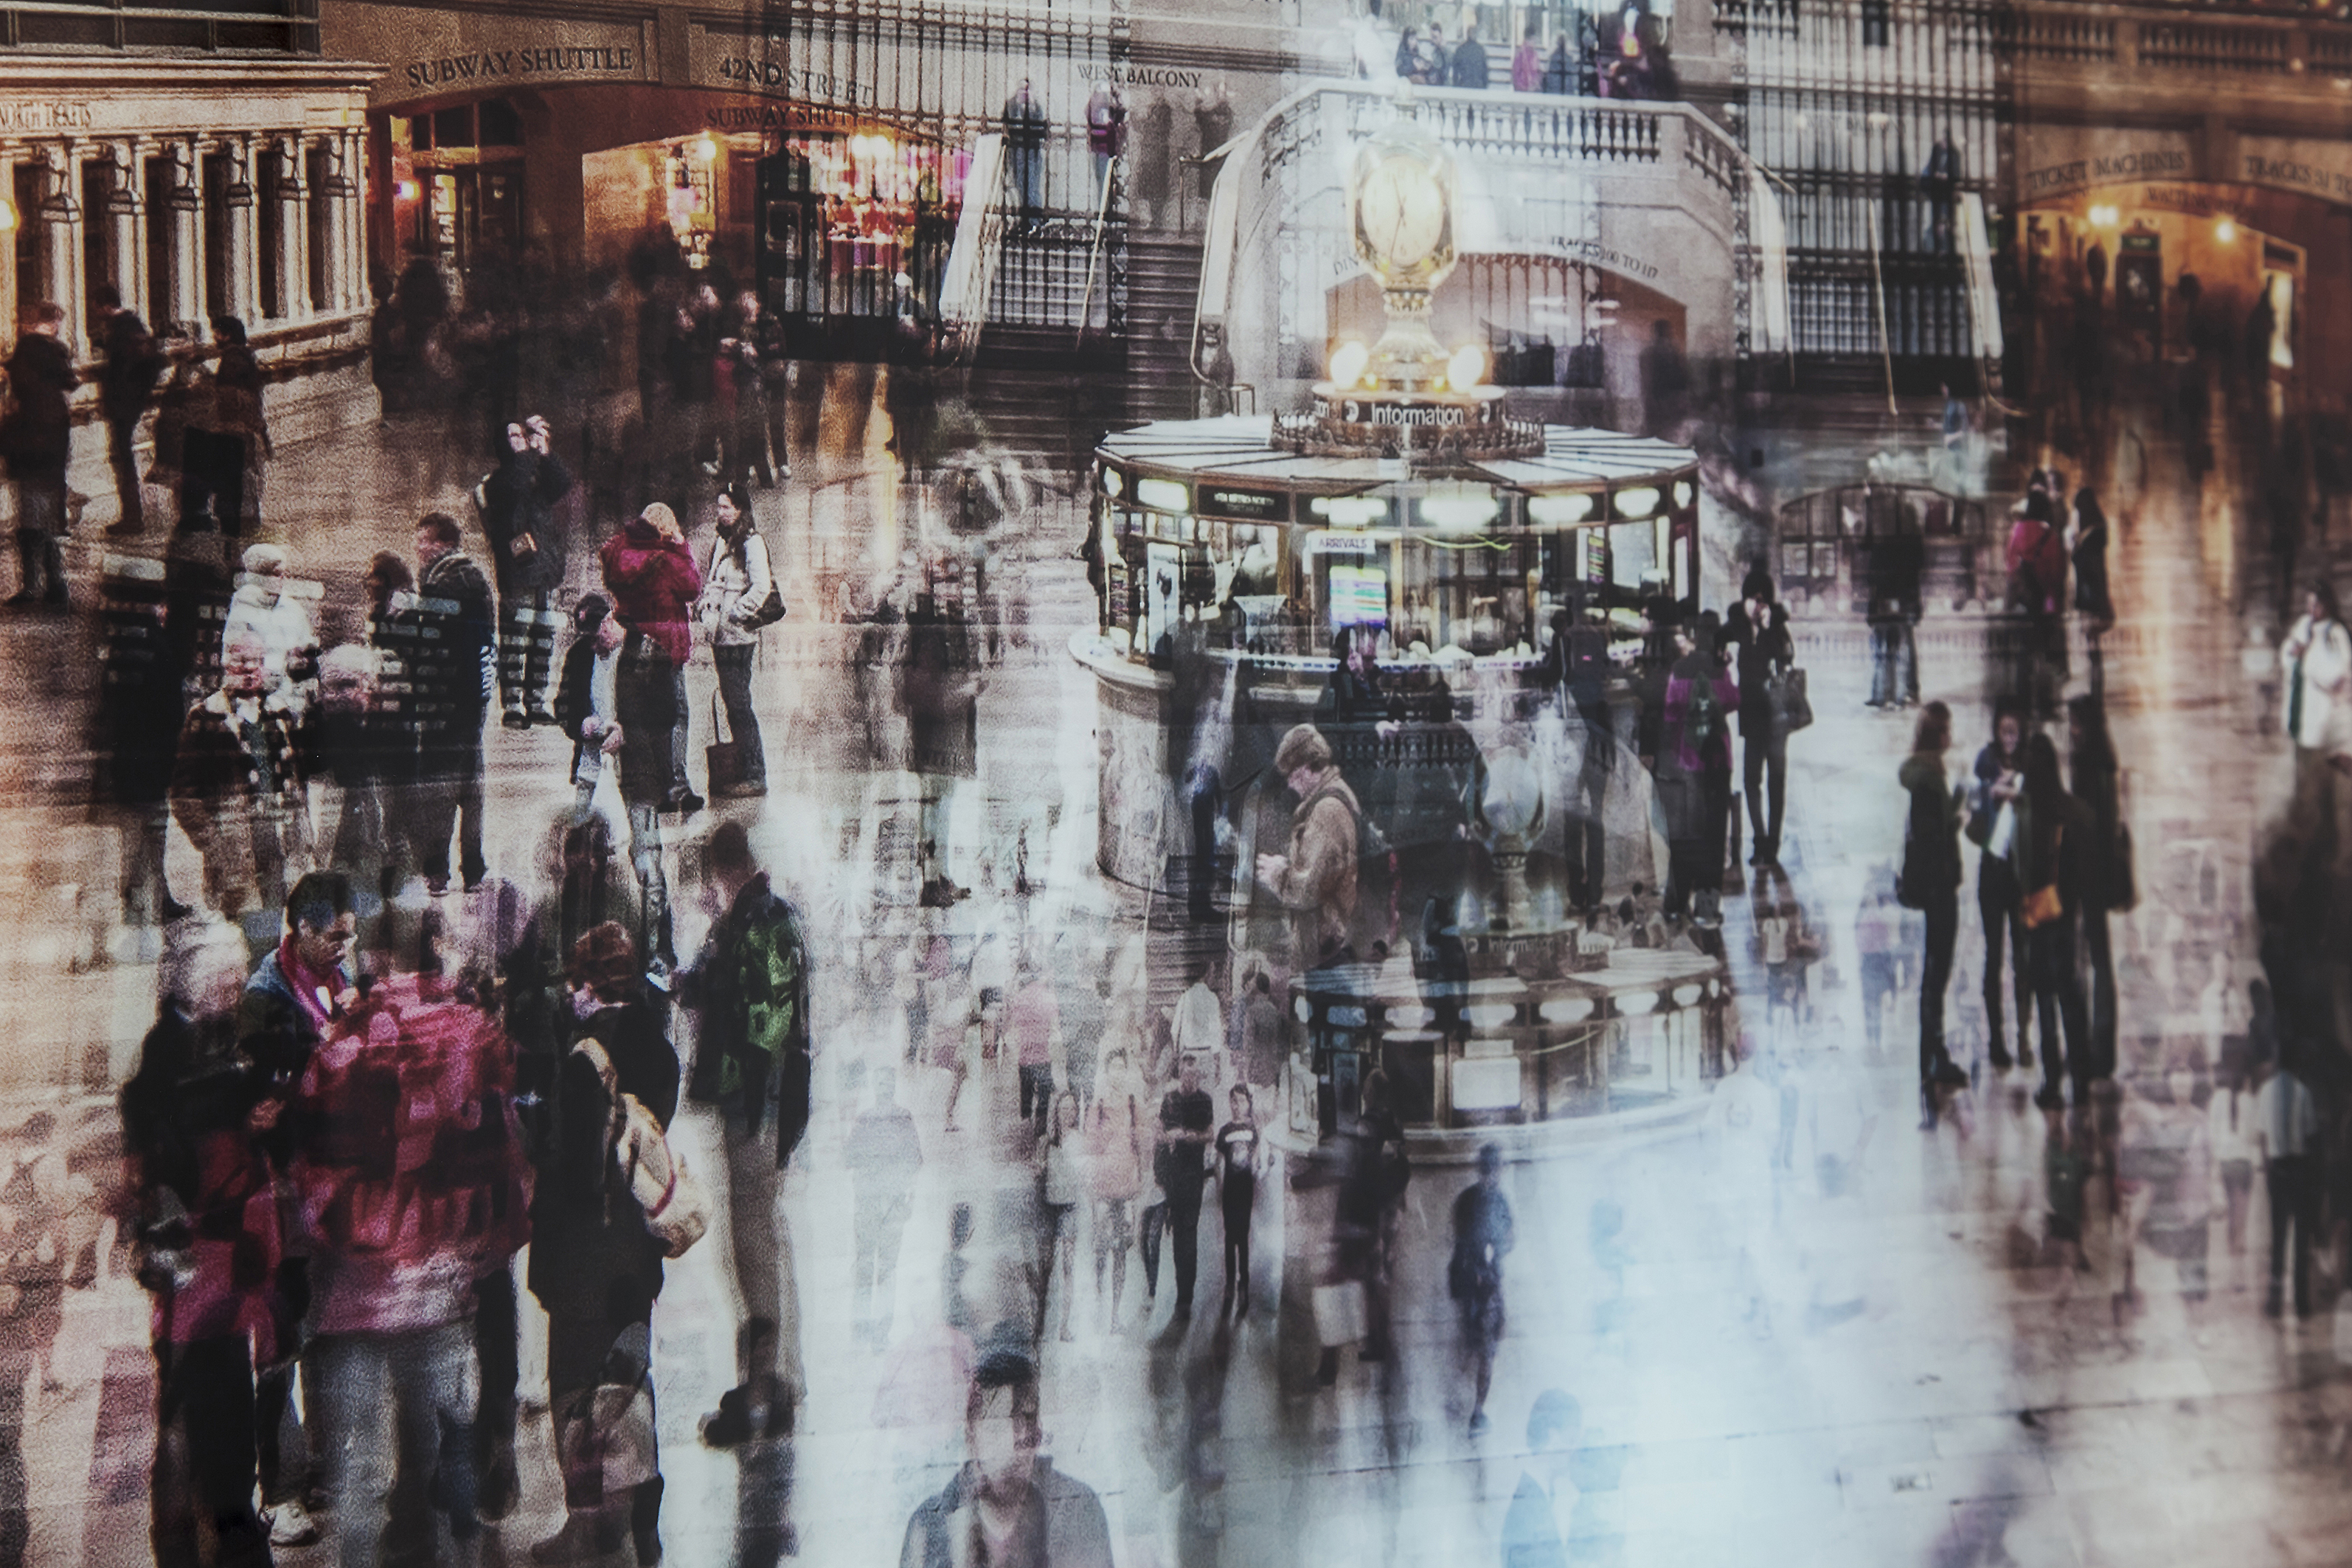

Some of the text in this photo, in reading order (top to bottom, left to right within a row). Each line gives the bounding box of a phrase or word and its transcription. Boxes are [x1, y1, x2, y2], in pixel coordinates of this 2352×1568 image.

[407, 46, 633, 88] SUBWAY SHUTTLE
[719, 58, 785, 87] 42ND
[1127, 67, 1201, 88] BALCONY
[706, 107, 788, 128] SUBWAY
[2025, 150, 2186, 190] TICKET MACHINES
[1623, 254, 1640, 271] TO
[1371, 403, 1464, 426] Information
[1319, 538, 1368, 549] ARRIVALS
